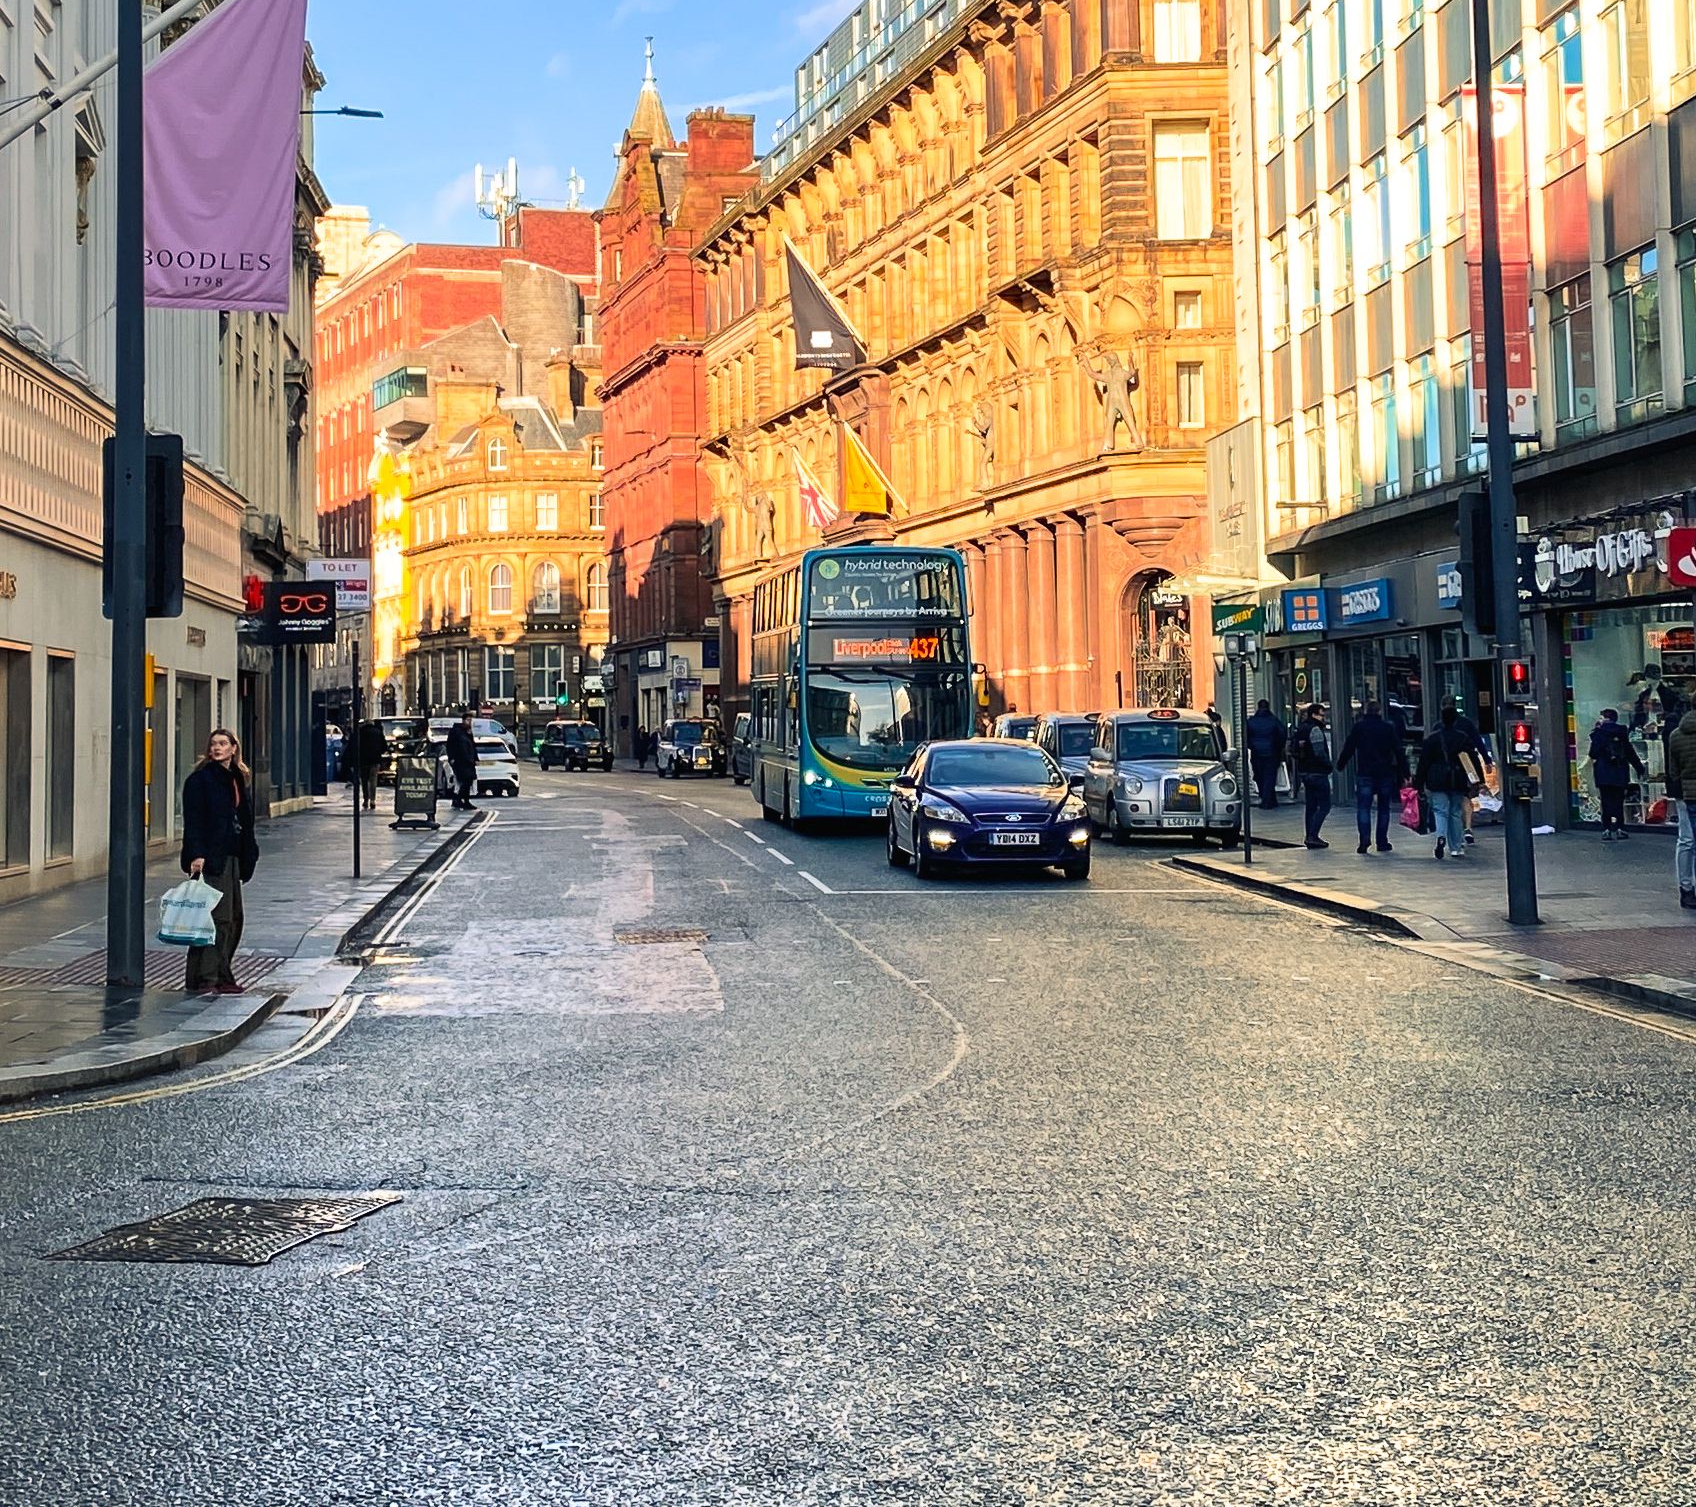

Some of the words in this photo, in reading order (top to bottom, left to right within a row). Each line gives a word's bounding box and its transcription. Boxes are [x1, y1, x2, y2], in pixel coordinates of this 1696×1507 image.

[144, 249, 272, 271] BOODLES
[184, 276, 223, 288] 1798
[322, 563, 336, 572] TO
[338, 563, 357, 572] LET
[845, 559, 882, 572] hybrid
[884, 559, 949, 573] technology
[919, 606, 948, 617] Arriva
[1215, 607, 1256, 632] SUBWAY
[1291, 622, 1324, 632] GREGGS
[834, 639, 887, 658] Liverpool
[911, 637, 939, 659] 437
[1018, 834, 1037, 844] DXZ
